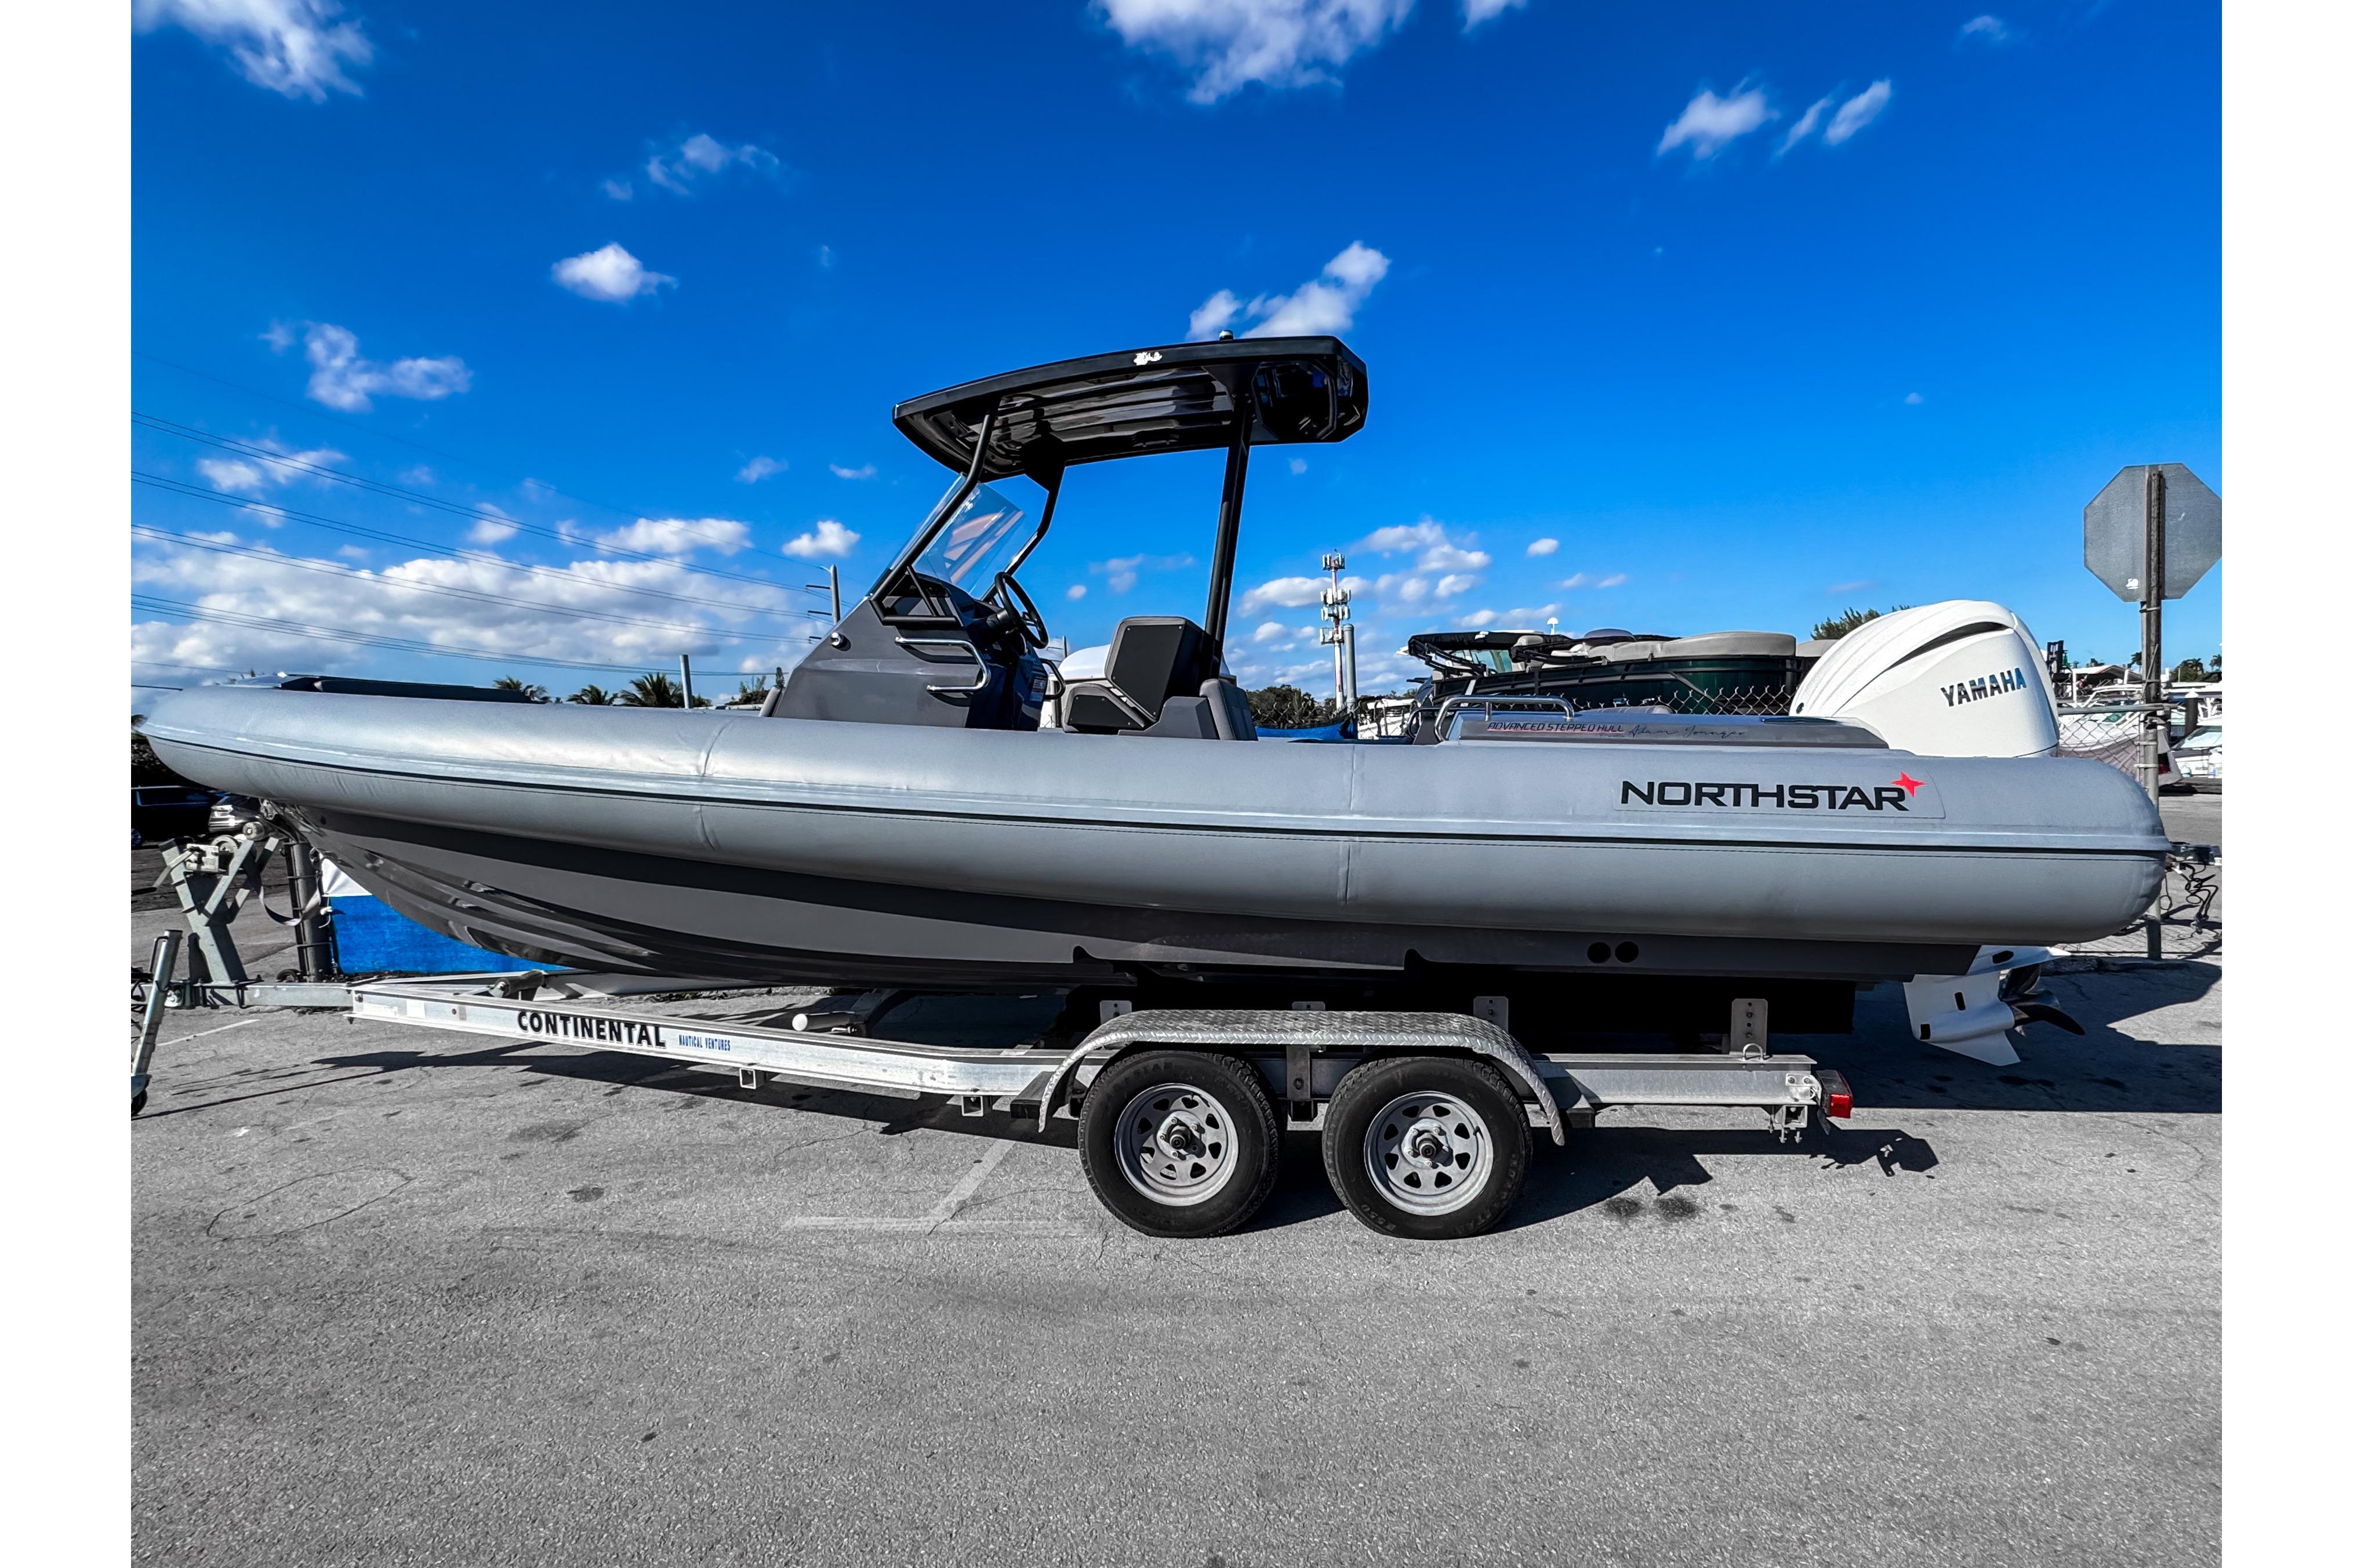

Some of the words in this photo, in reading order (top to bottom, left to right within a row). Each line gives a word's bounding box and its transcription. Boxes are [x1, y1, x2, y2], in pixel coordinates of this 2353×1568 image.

[1941, 667, 2027, 707] YAMAHA
[1487, 722, 1545, 731] ADVANCED
[1548, 723, 1596, 732] STEPPED
[1597, 724, 1624, 732] HULL
[1621, 780, 1910, 812] NORTHSTAR
[517, 1010, 667, 1049] CONTINENTAL
[679, 1035, 703, 1048] NAUTICAL
[705, 1038, 731, 1051] VENTURES
